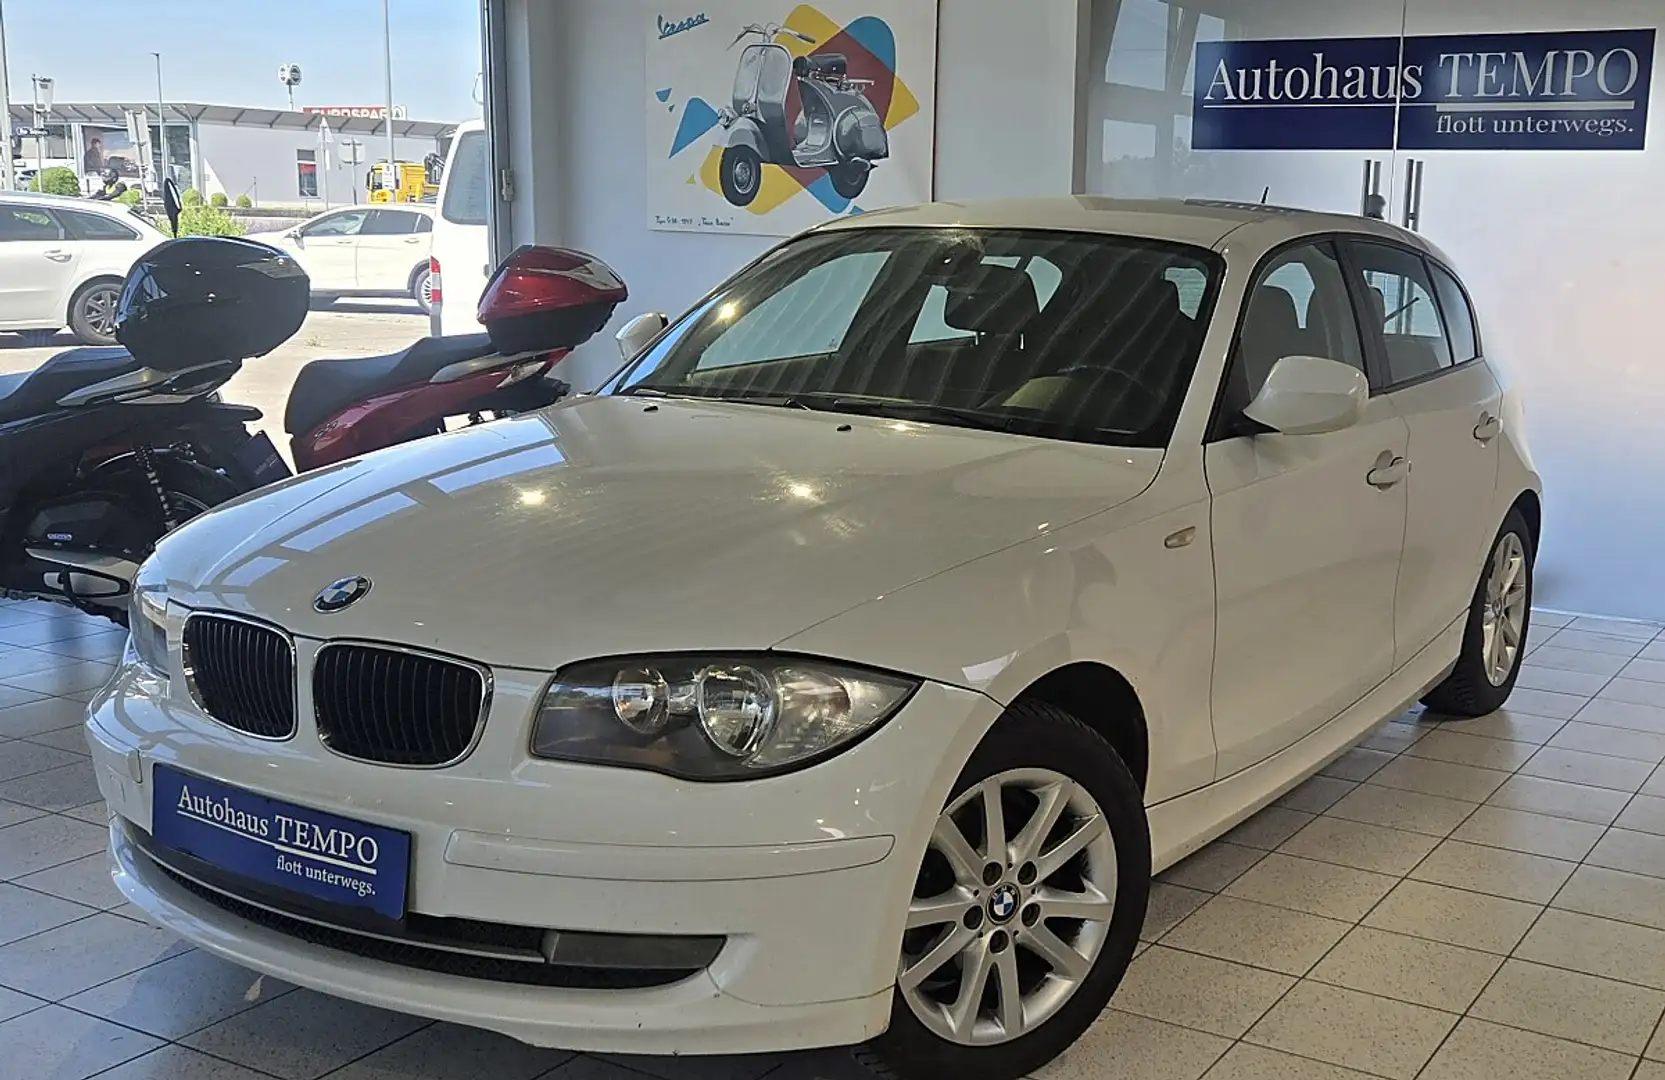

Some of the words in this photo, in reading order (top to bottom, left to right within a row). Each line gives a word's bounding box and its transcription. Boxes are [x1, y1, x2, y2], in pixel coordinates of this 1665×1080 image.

[658, 13, 709, 40] Vespa
[1203, 52, 1424, 101] Autohaus
[1438, 48, 1639, 97] TEMPO
[1436, 115, 1486, 133] flott
[1493, 117, 1634, 136] unterwegs.
[177, 785, 269, 836] Autohaus
[275, 815, 379, 865] TEMPO
[276, 855, 303, 877] flott
[305, 865, 377, 897] unterwegs.
